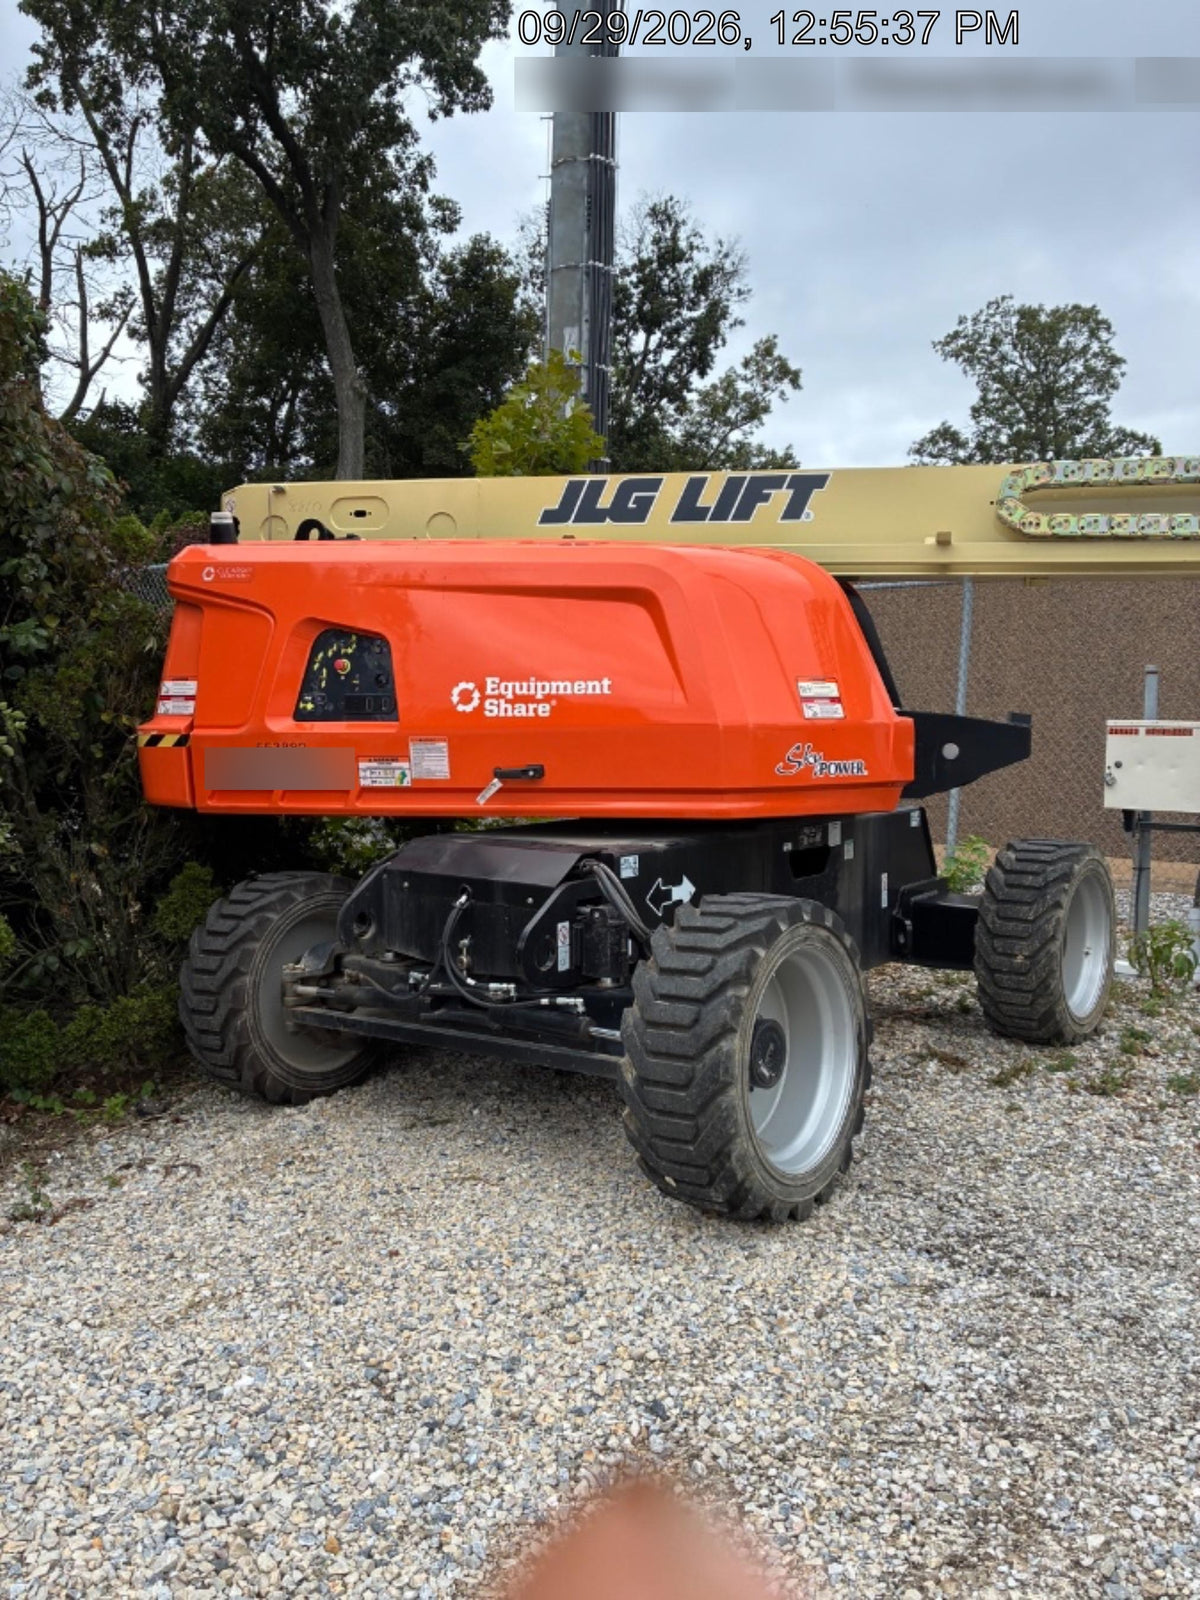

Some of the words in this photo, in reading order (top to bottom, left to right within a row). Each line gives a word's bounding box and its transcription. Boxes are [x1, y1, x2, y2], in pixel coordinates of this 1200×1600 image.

[537, 475, 666, 526] JLG
[668, 471, 832, 525] LIFT
[484, 676, 612, 699] Equipment
[484, 698, 551, 717] Share
[775, 743, 824, 778] Sky
[819, 759, 867, 776] POWER
